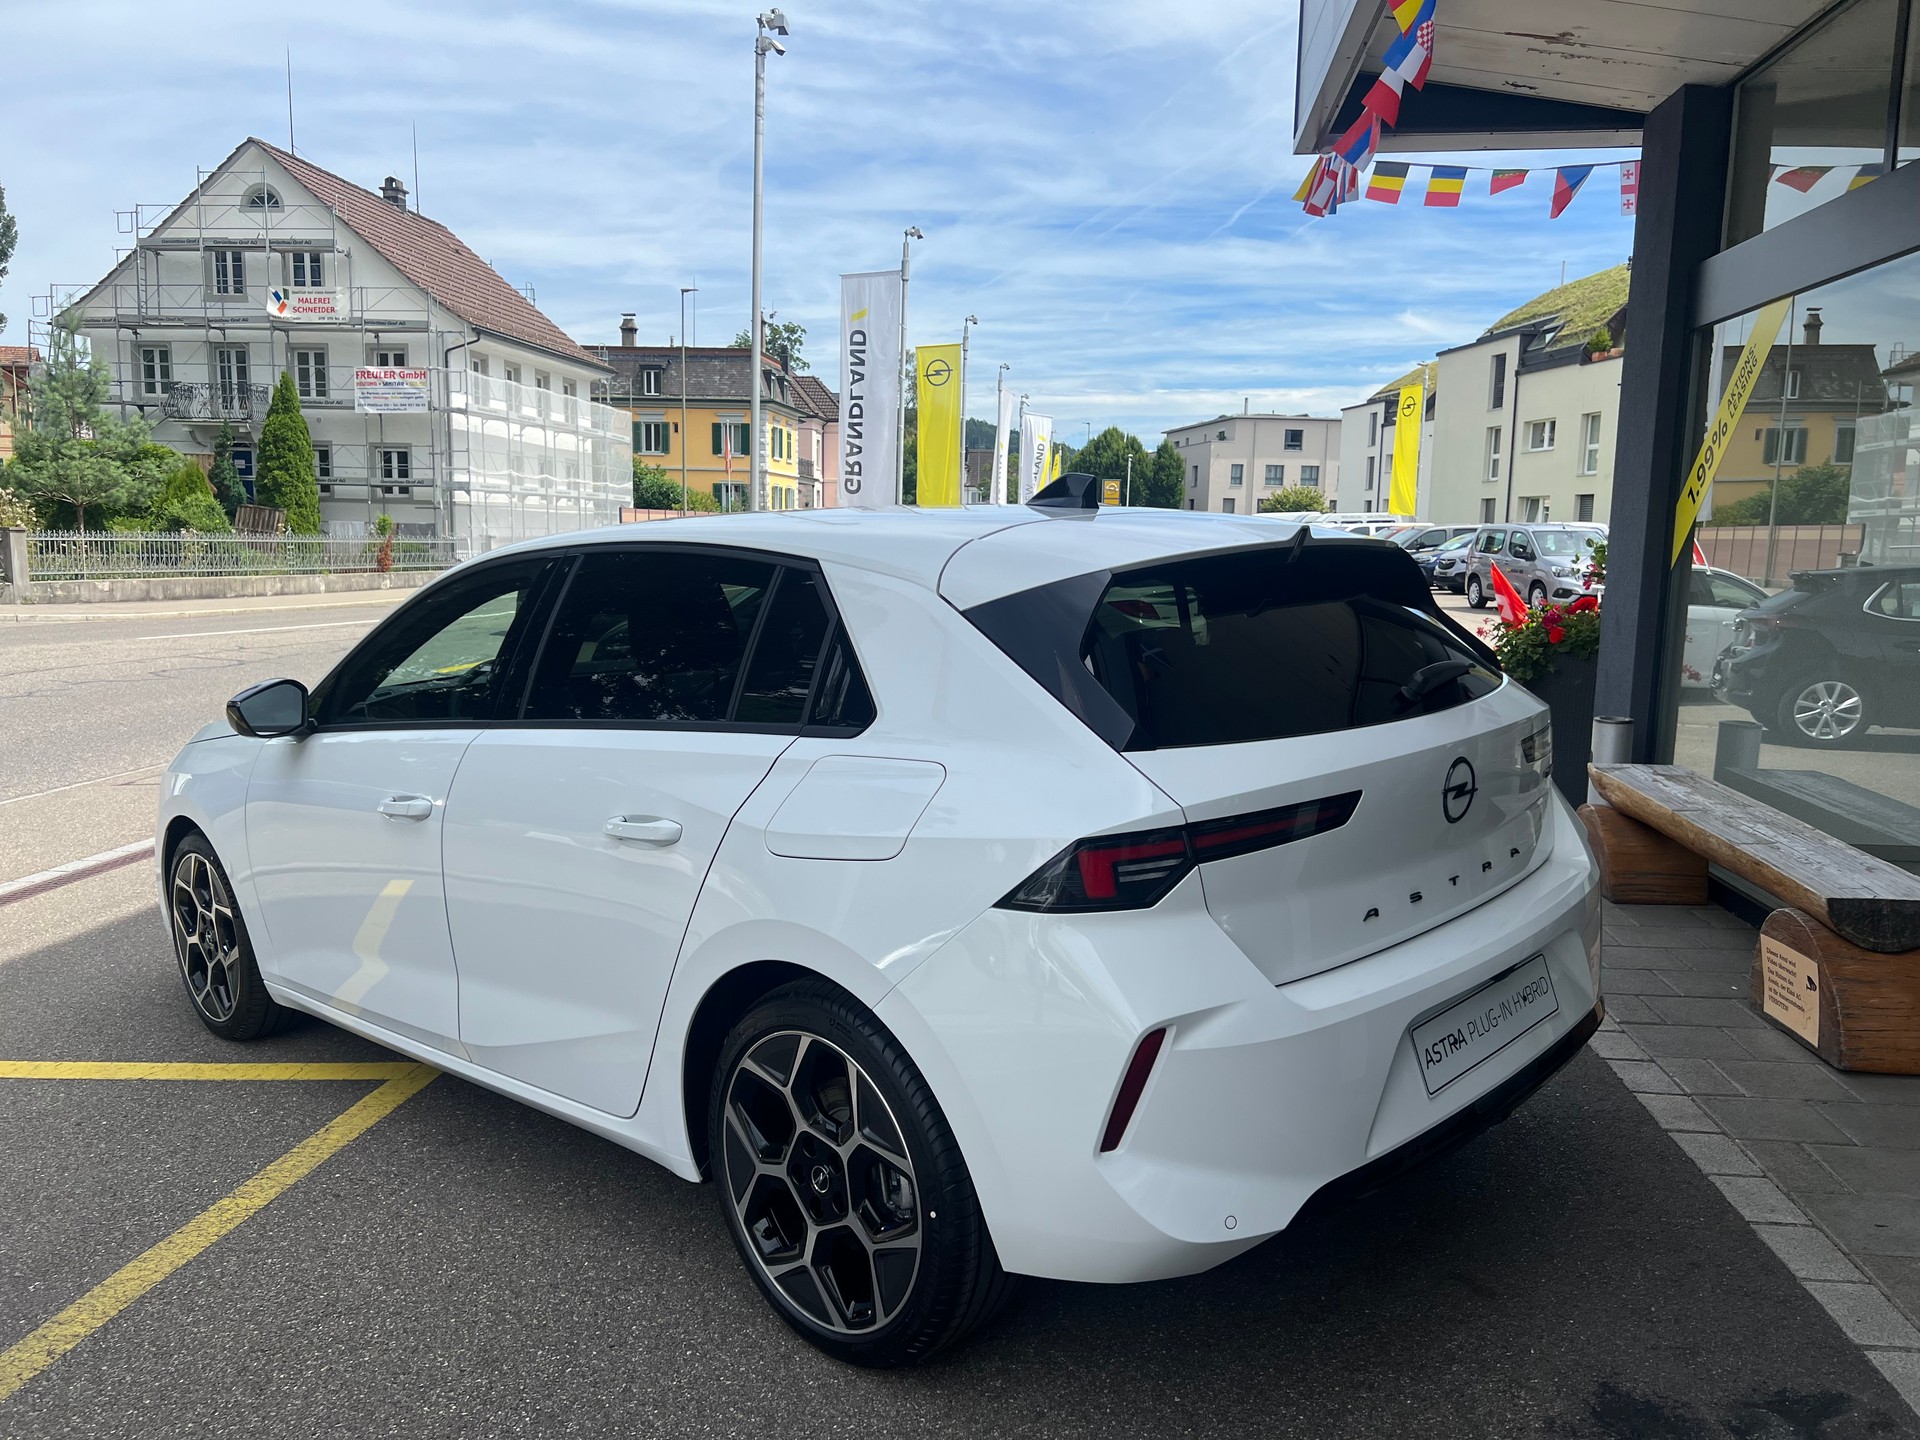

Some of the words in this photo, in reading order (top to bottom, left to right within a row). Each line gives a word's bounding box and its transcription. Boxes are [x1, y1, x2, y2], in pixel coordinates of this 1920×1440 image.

[356, 370, 396, 379] FREULER
[399, 371, 426, 379] GmbH
[1727, 344, 1757, 411] AKTIONS-
[1730, 358, 1758, 419] LEASING
[1688, 418, 1728, 505] 1.99%
[1362, 848, 1520, 922] ASTRA
[1424, 1028, 1468, 1070] ASTRA
[1467, 999, 1513, 1042] PLUG-IN
[1513, 976, 1549, 1012] HYBRID
